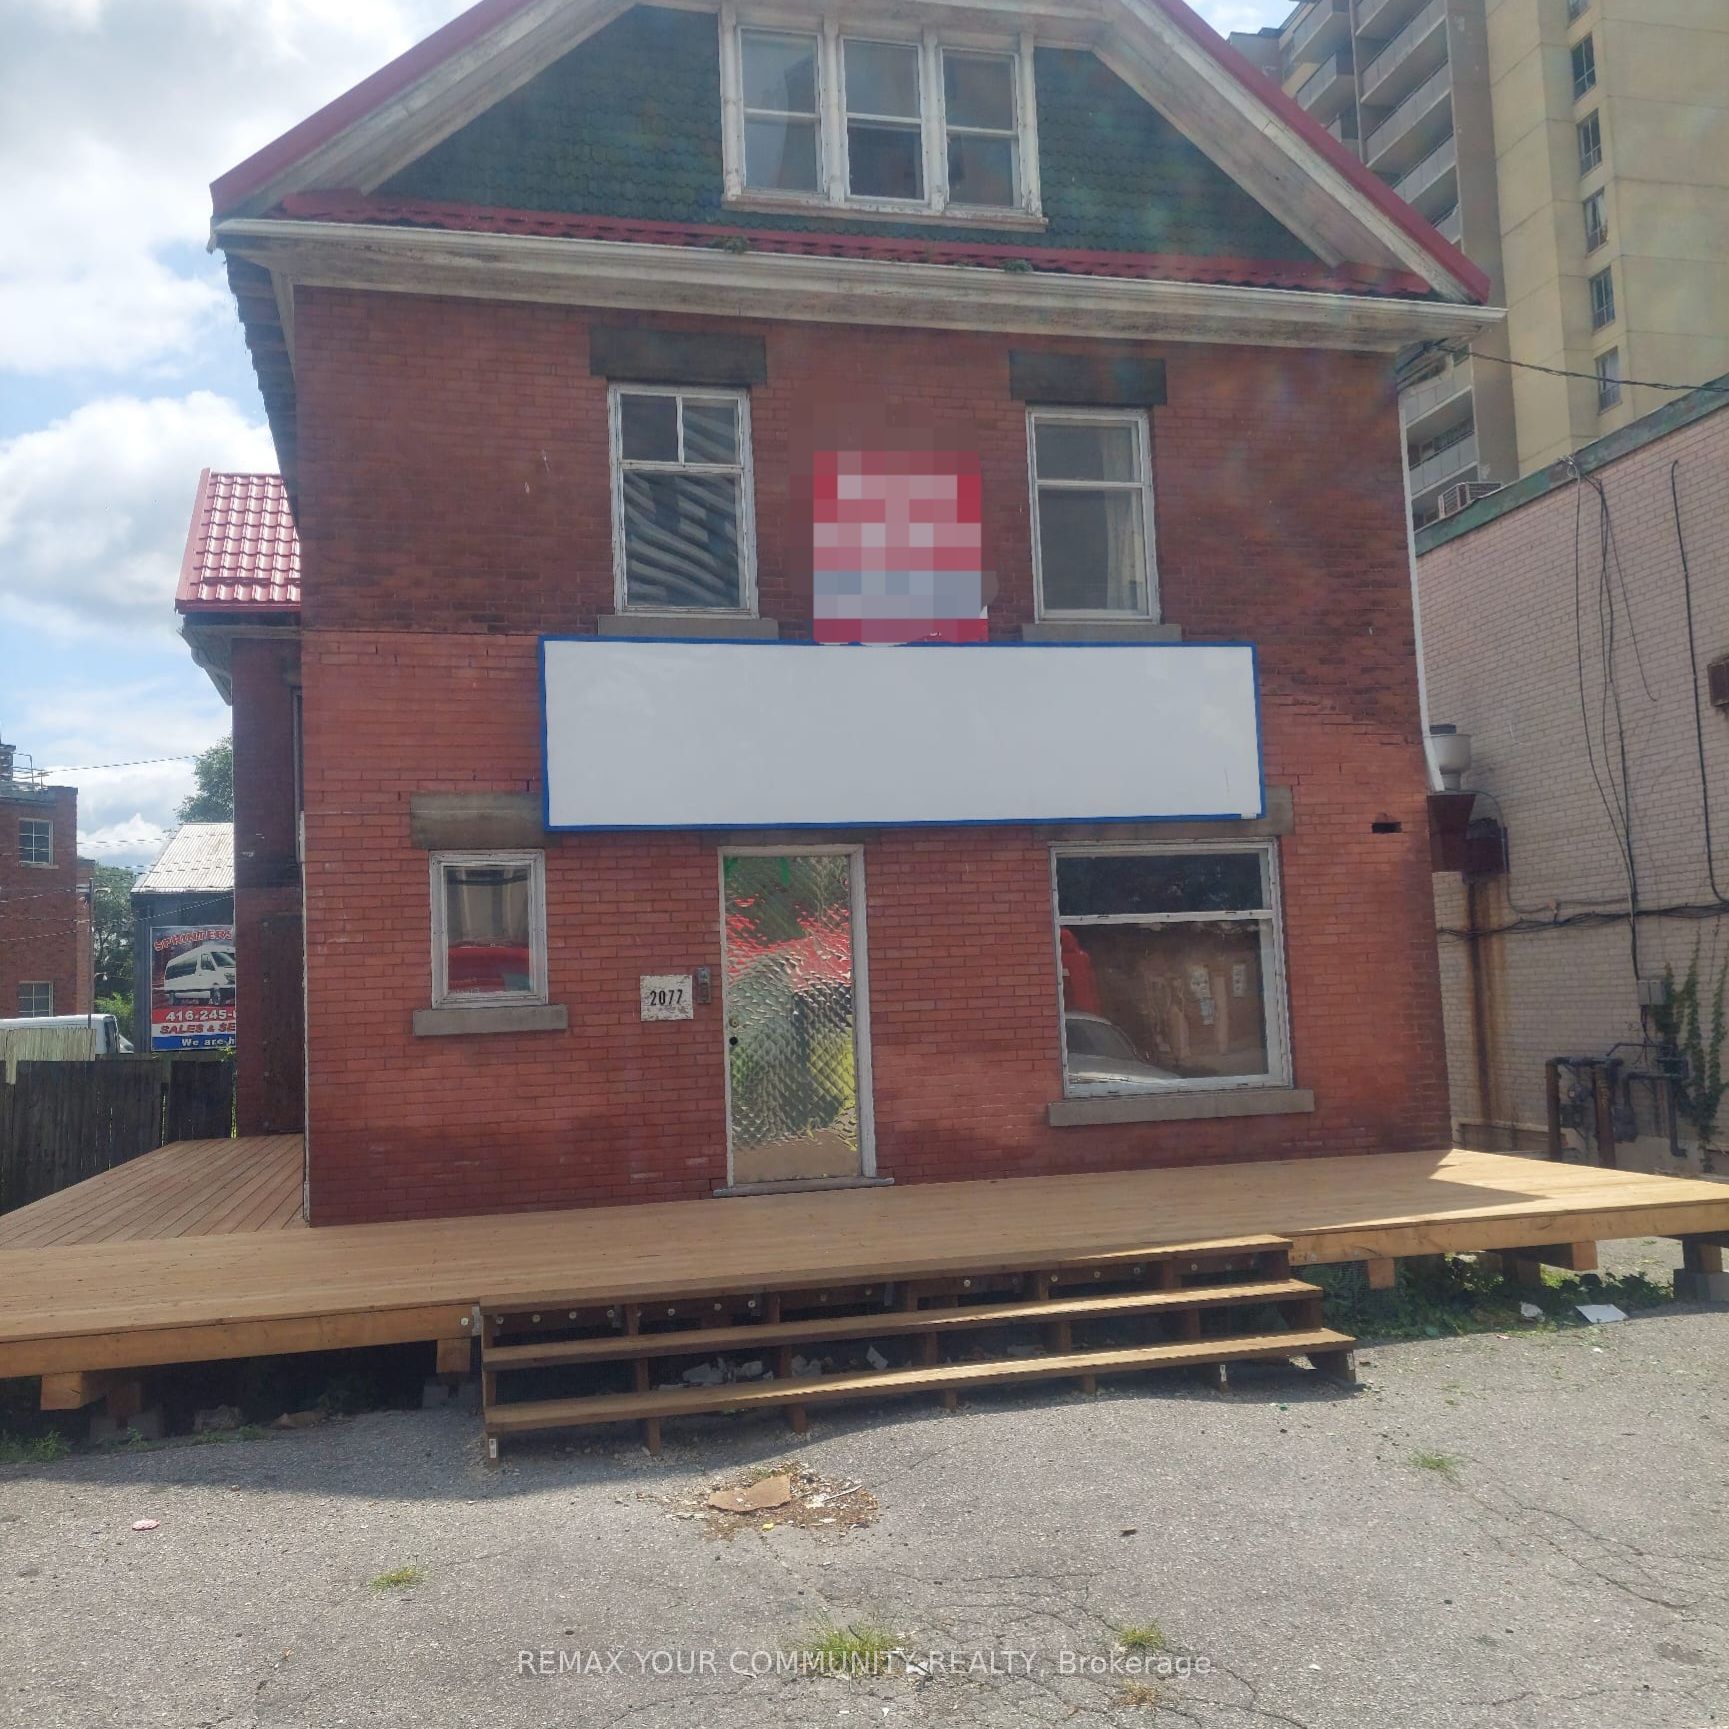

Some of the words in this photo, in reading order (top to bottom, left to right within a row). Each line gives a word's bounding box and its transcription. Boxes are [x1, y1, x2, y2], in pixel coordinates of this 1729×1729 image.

[650, 989, 683, 1006] 2077
[160, 1024, 204, 1034] SALES
[182, 1038, 199, 1047] We
